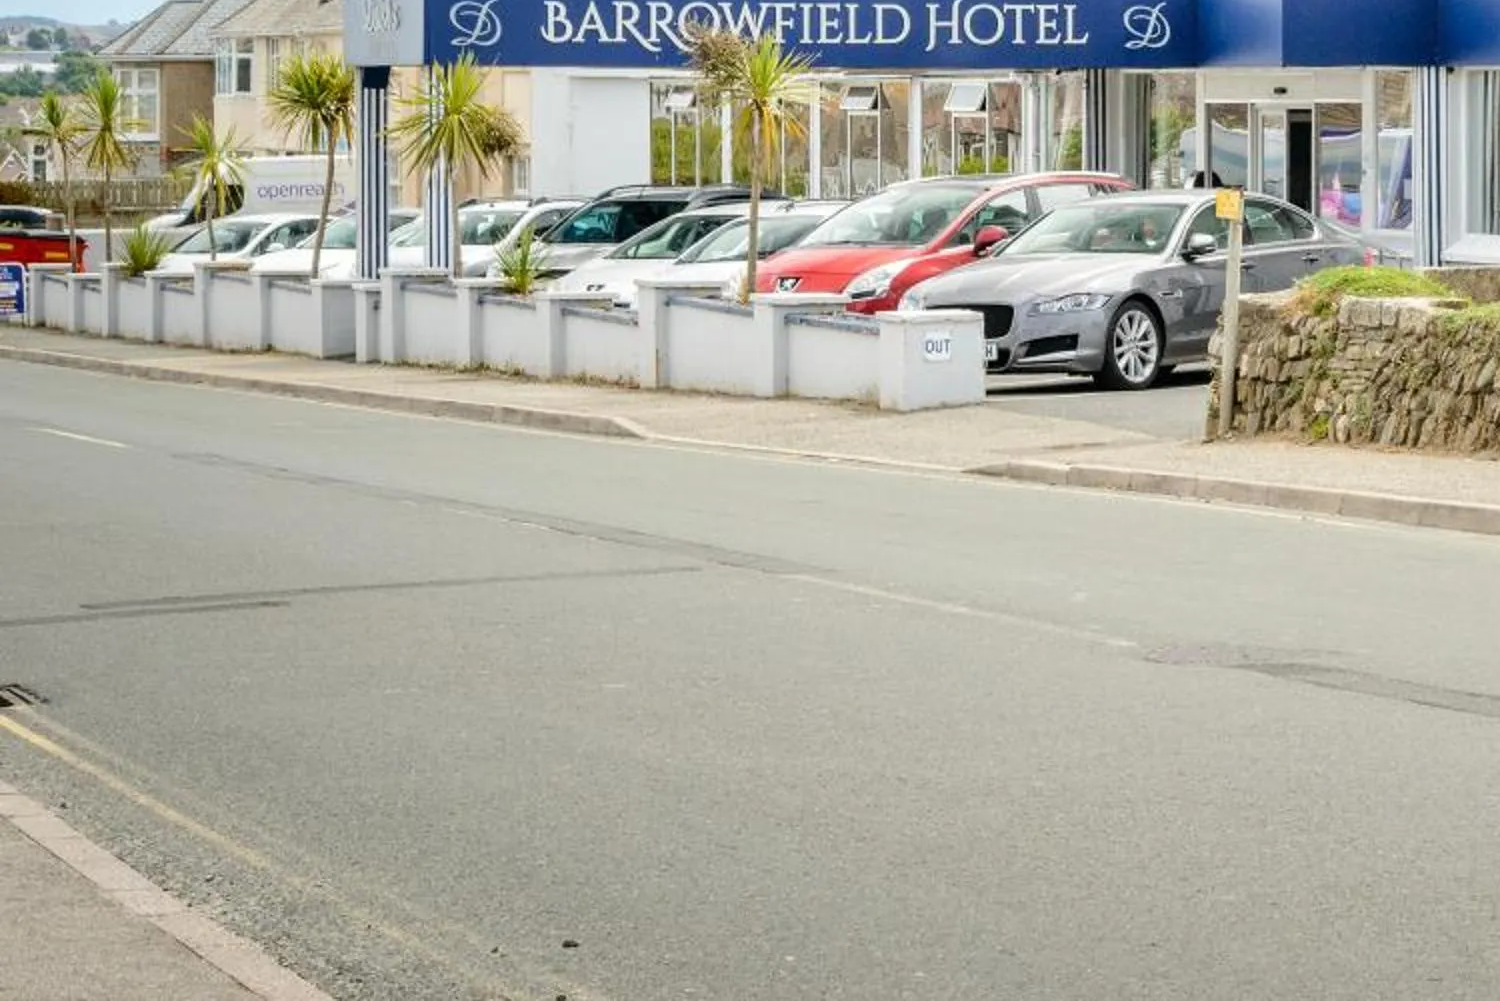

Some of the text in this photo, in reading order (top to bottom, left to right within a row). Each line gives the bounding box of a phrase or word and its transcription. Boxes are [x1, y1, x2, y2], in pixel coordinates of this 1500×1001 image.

[540, 0, 911, 52] BARROWFIELD
[256, 181, 345, 200] openreah
[925, 338, 951, 353] OUT
